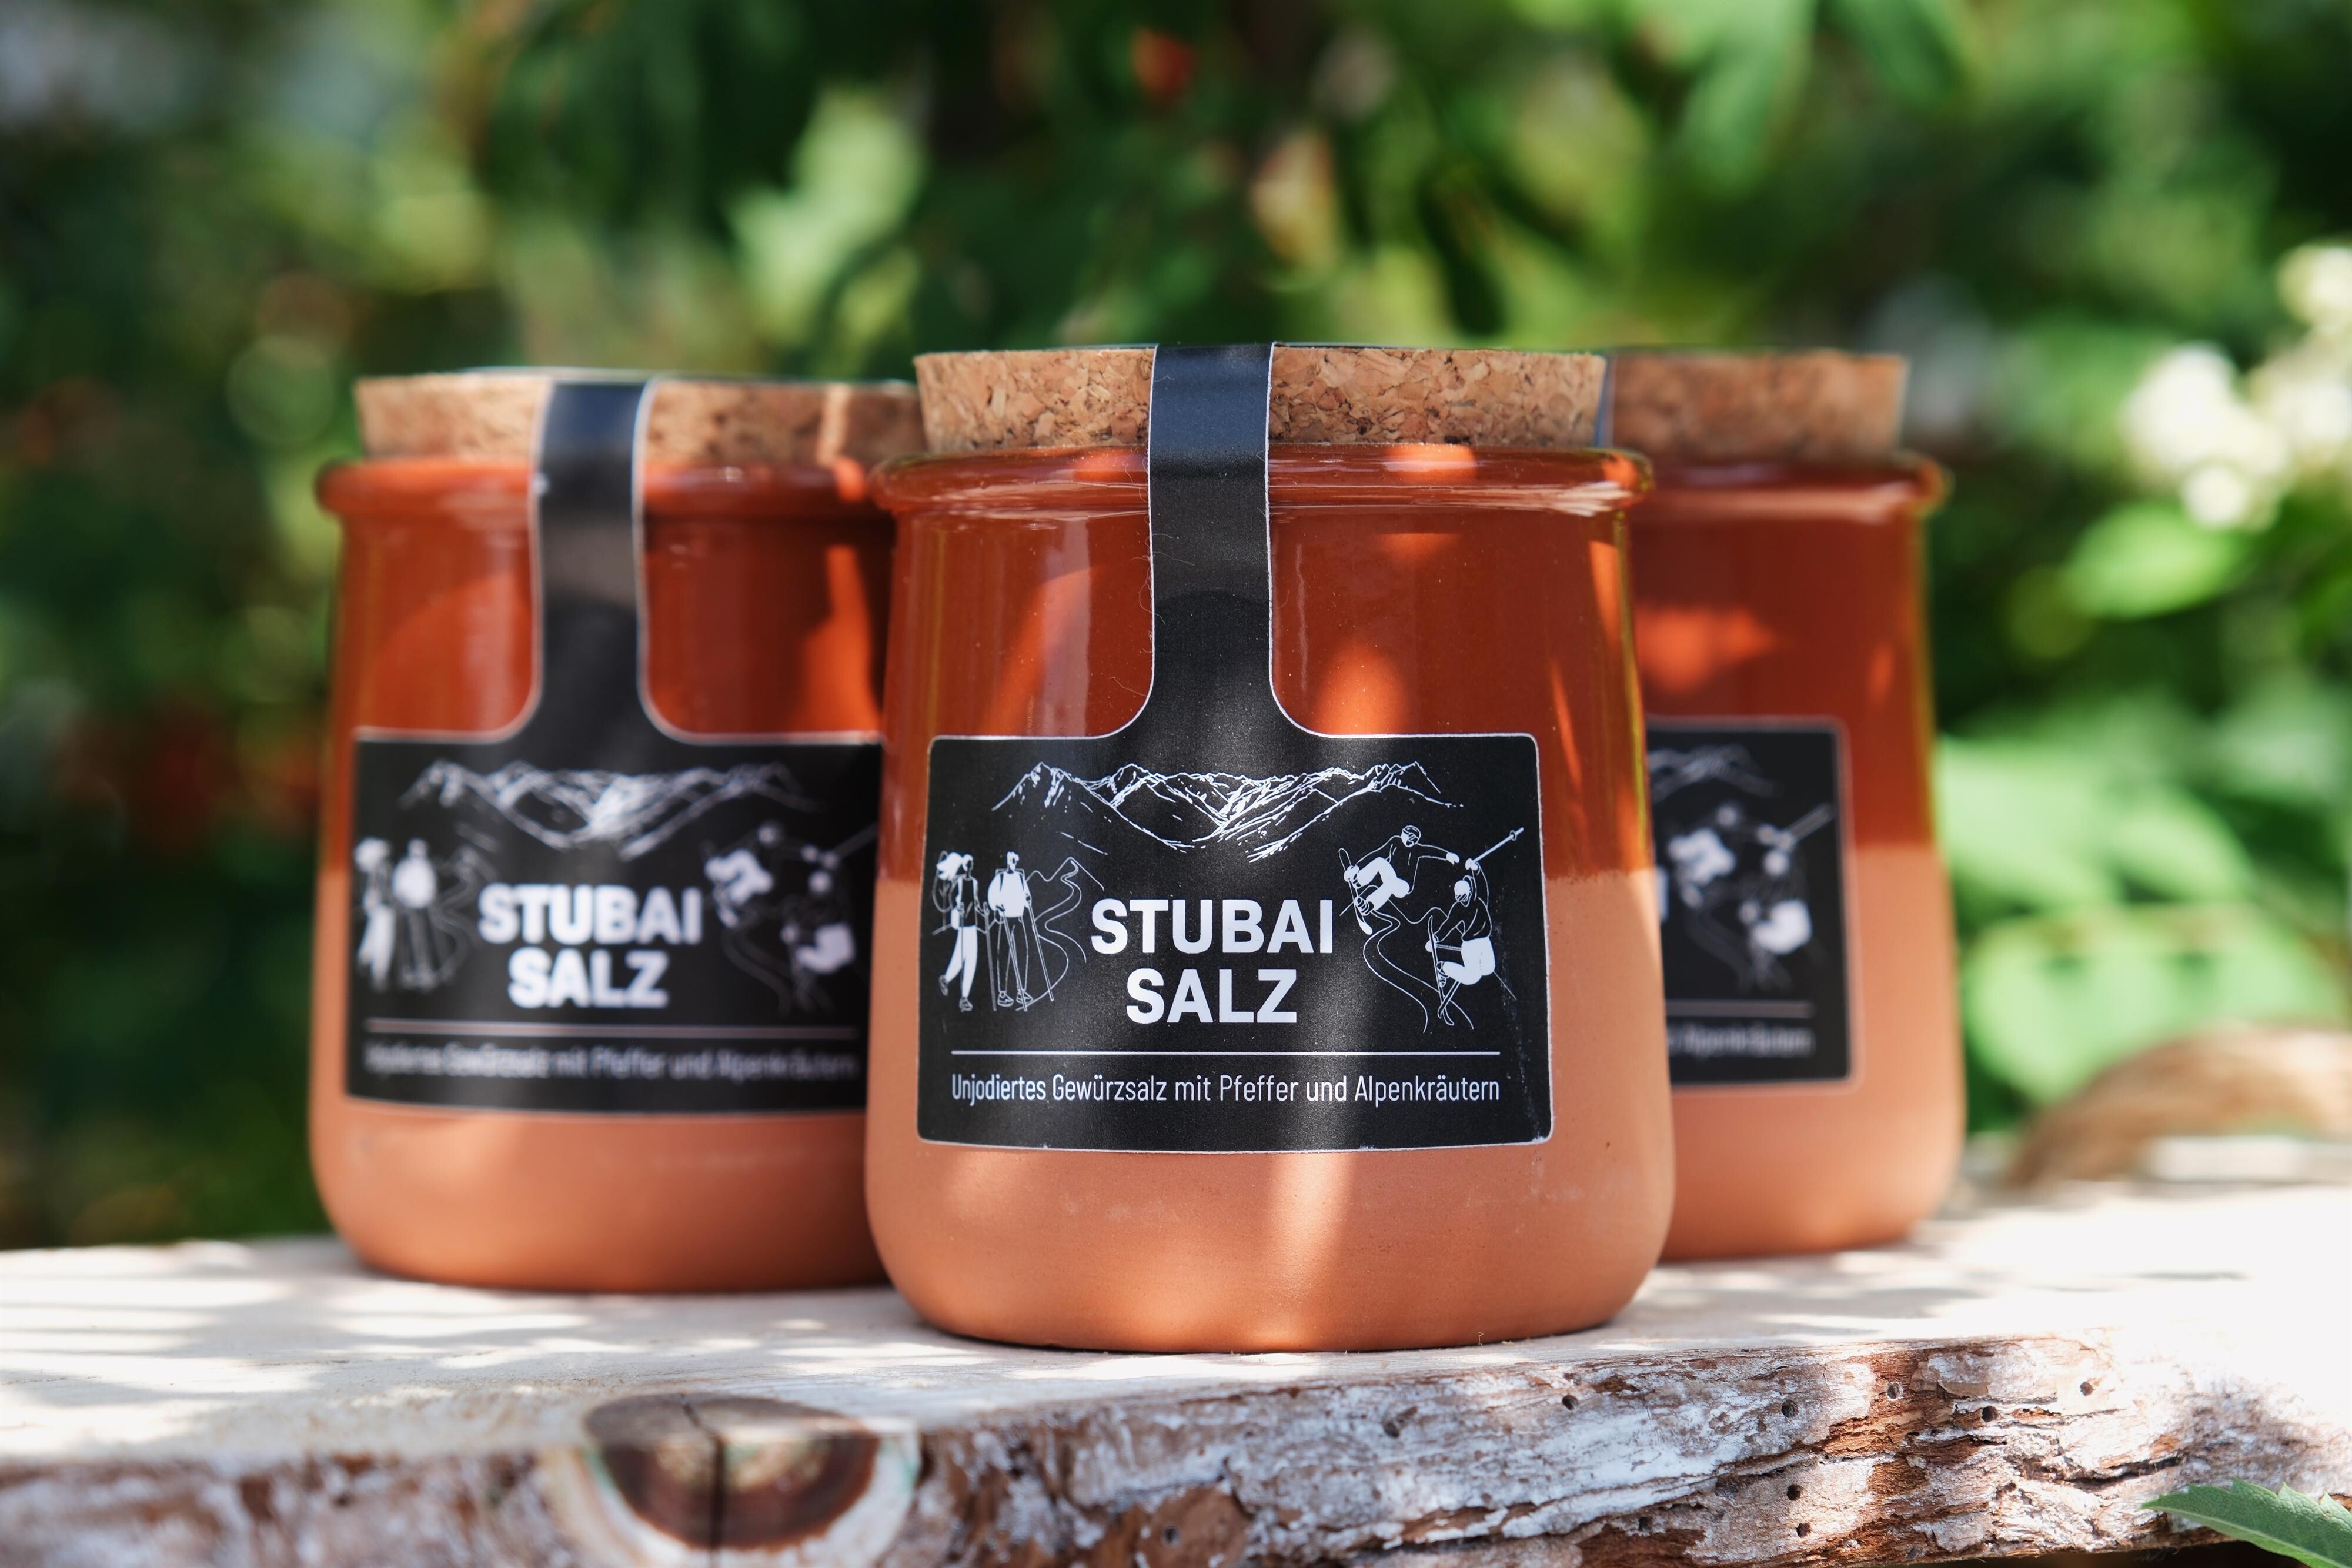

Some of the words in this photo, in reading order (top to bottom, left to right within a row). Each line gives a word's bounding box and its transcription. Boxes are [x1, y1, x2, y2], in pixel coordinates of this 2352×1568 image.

[478, 882, 701, 944] STUBAI
[1091, 898, 1333, 955] STUBAI
[507, 947, 669, 1008] SALZ
[1126, 968, 1297, 1024] SALZ
[951, 1074, 1047, 1106] Unjodiertes
[1053, 1074, 1167, 1101] Gewürzsalz
[1175, 1075, 1211, 1101] mit
[1220, 1075, 1299, 1102] Pfeffer
[1306, 1074, 1347, 1102] und
[1354, 1075, 1500, 1108] Alpenkräutern
